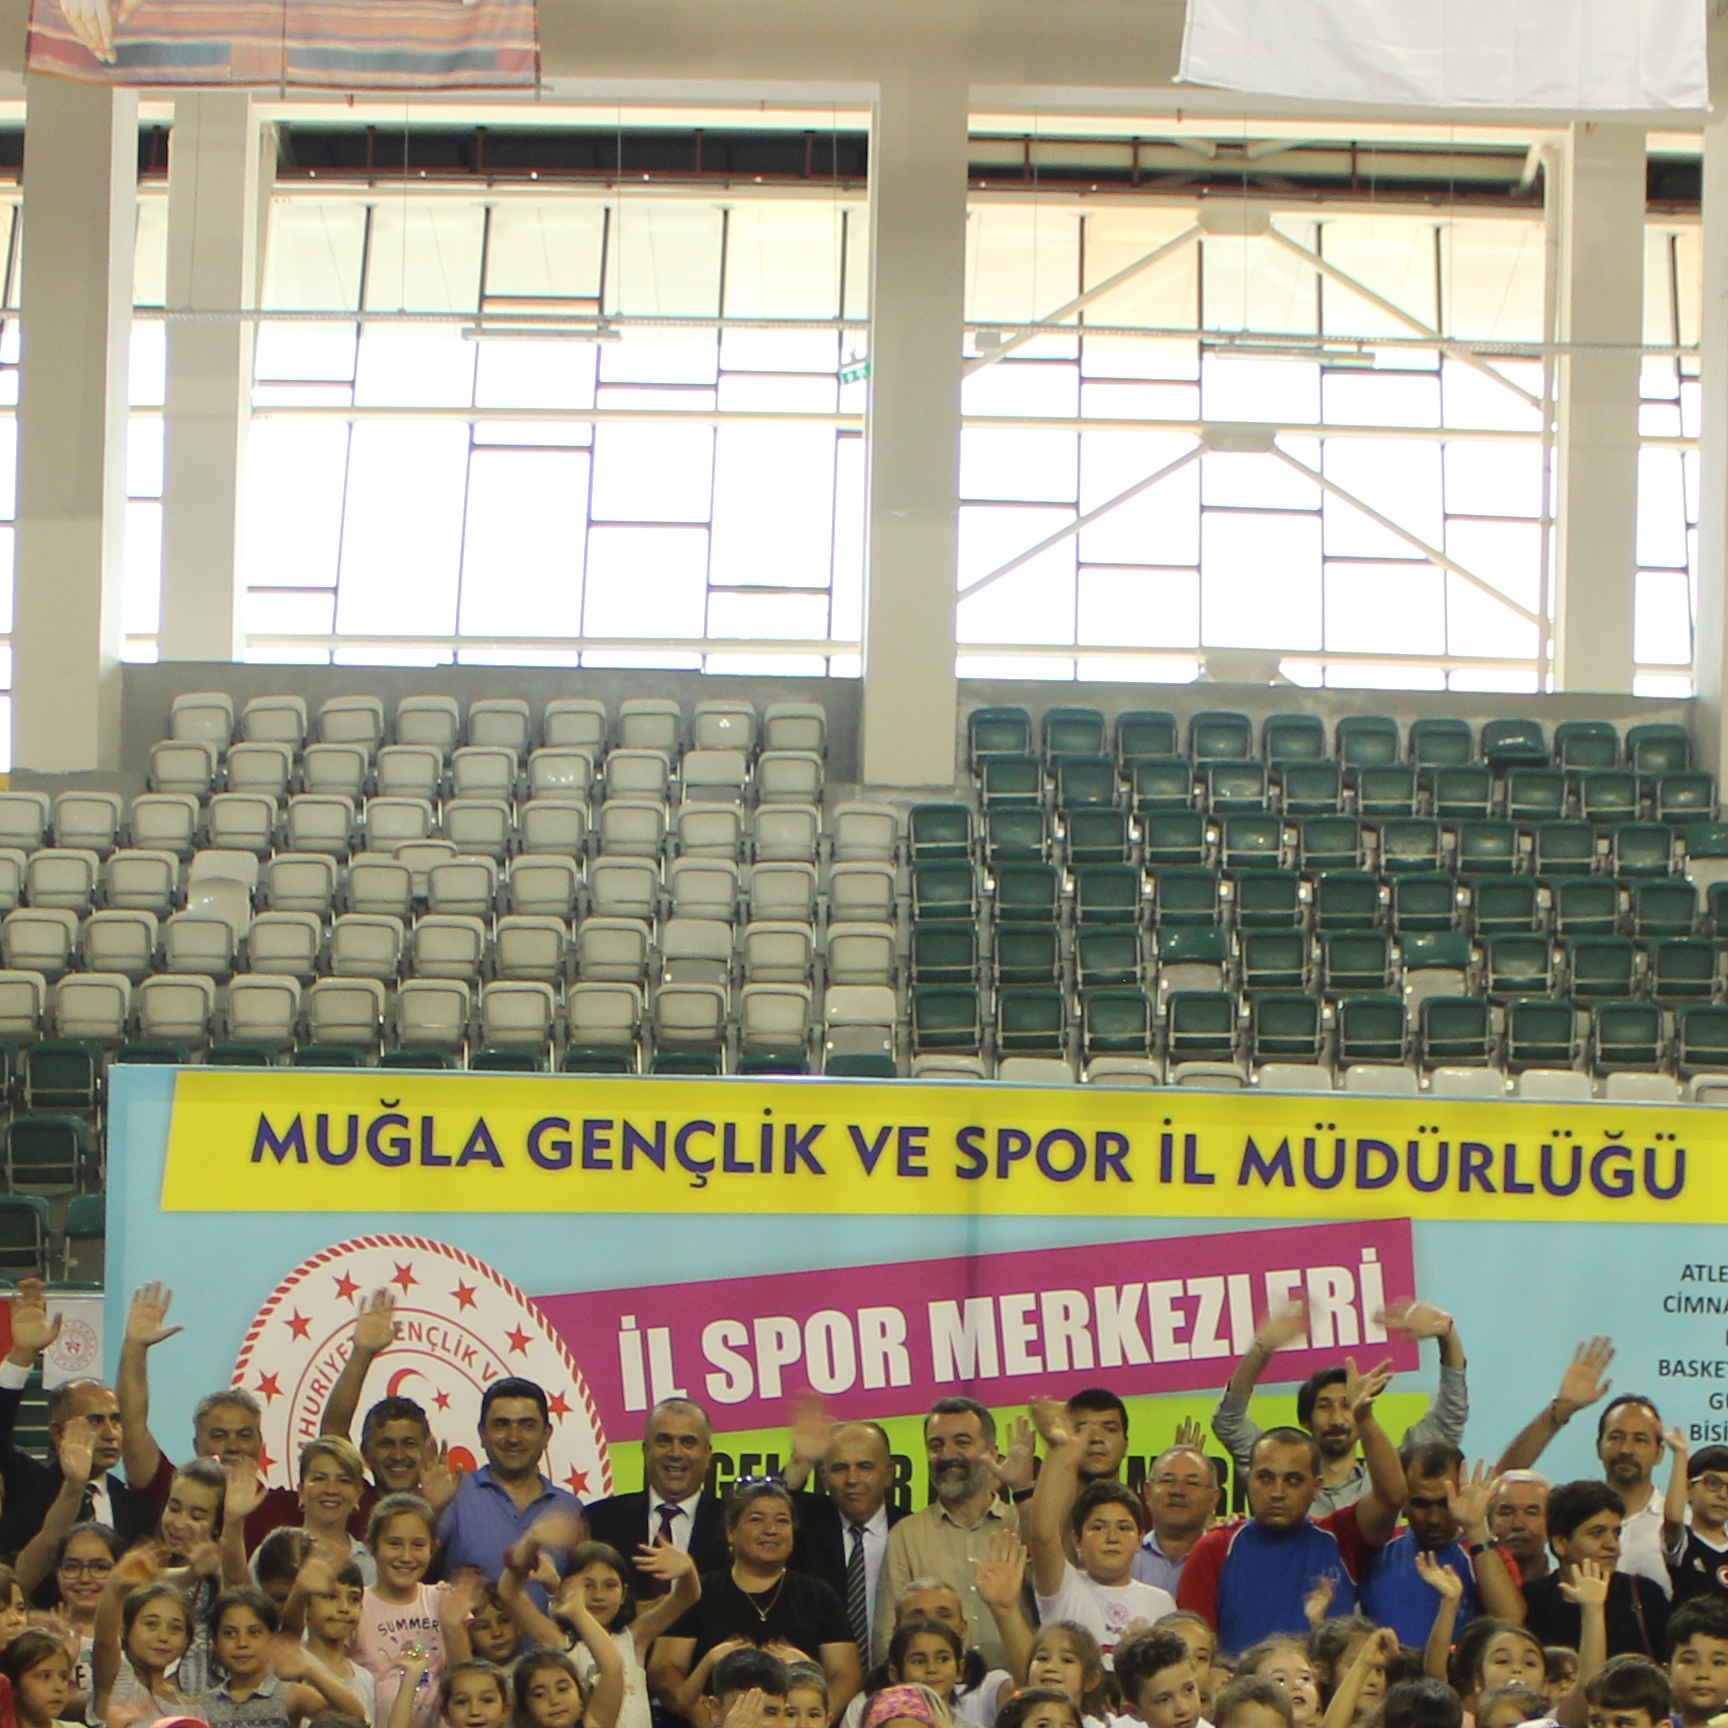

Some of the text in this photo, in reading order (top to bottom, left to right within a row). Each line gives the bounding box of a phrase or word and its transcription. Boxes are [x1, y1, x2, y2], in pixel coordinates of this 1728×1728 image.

[251, 1100, 1687, 1200] MUĞLA GENÇLİK VE SPOR İL MÜDÜRLÜĞÜ
[618, 1313, 688, 1413] İL
[699, 1304, 912, 1405] SPOR
[377, 1617, 439, 1637] SUMMER
